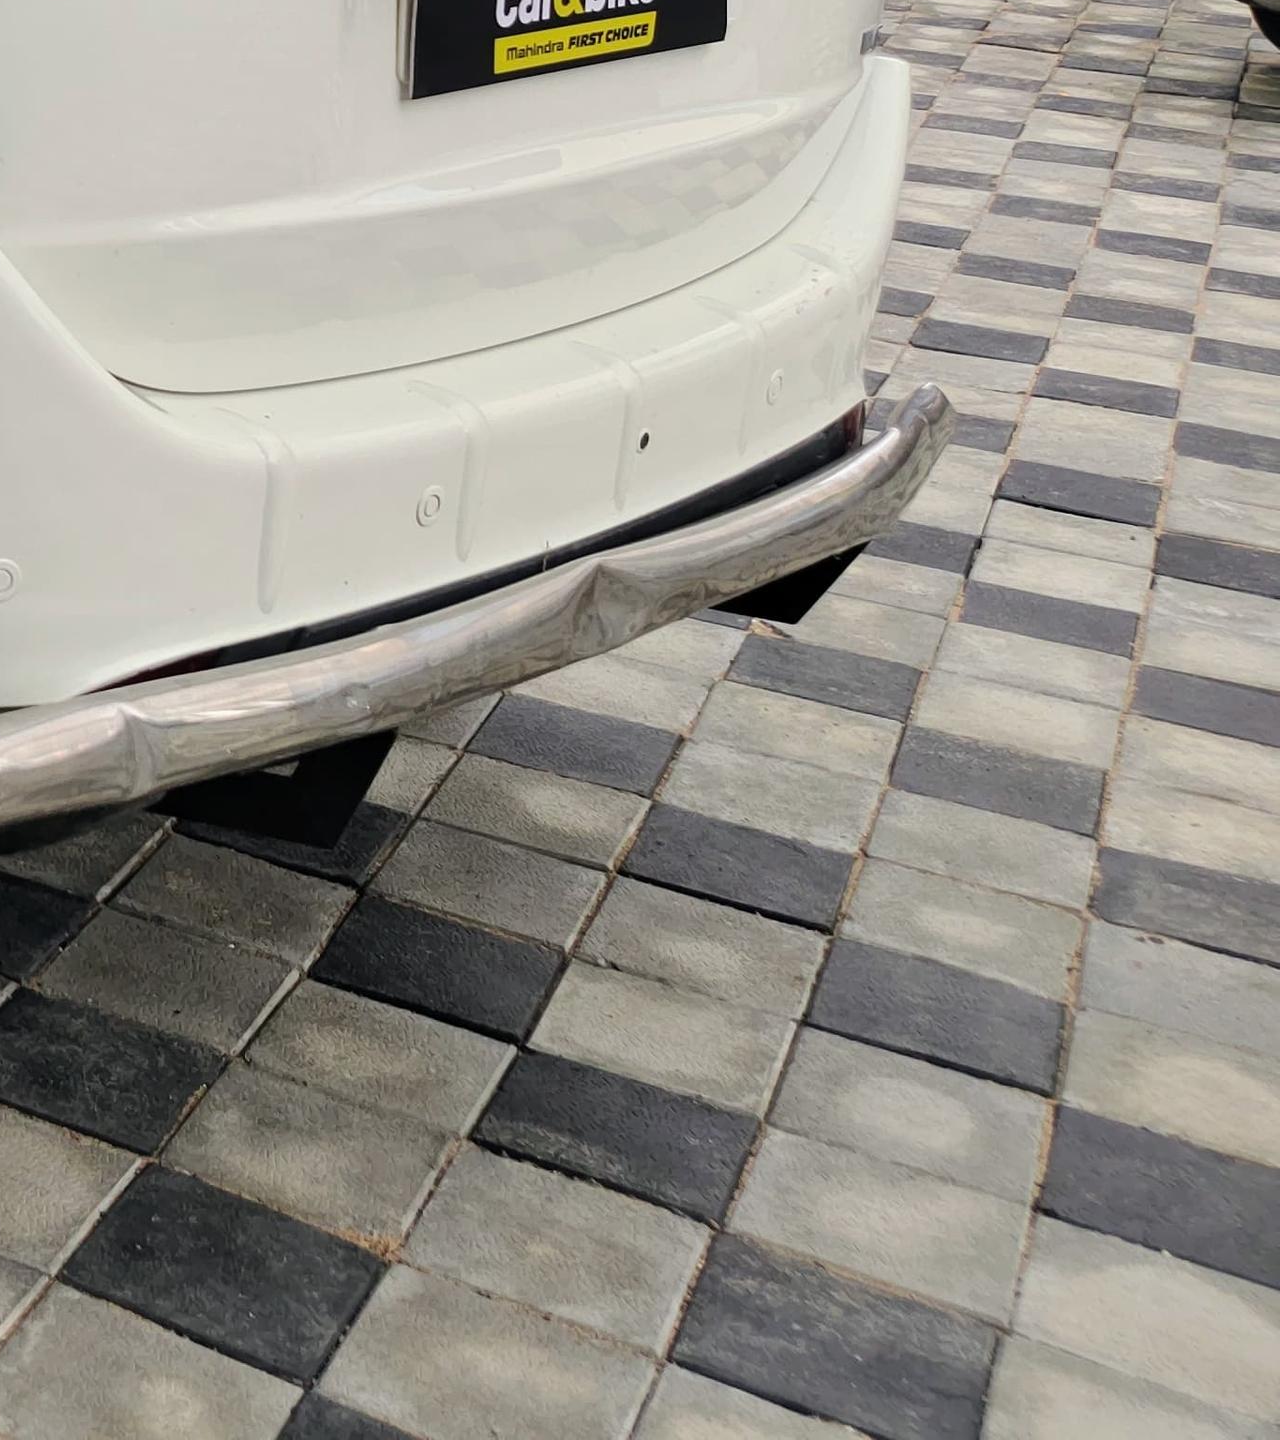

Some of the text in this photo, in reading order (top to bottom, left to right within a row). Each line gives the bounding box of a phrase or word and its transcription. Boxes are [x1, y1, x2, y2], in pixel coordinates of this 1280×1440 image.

[506, 23, 650, 61] Mahindra FIRST CHOICE
